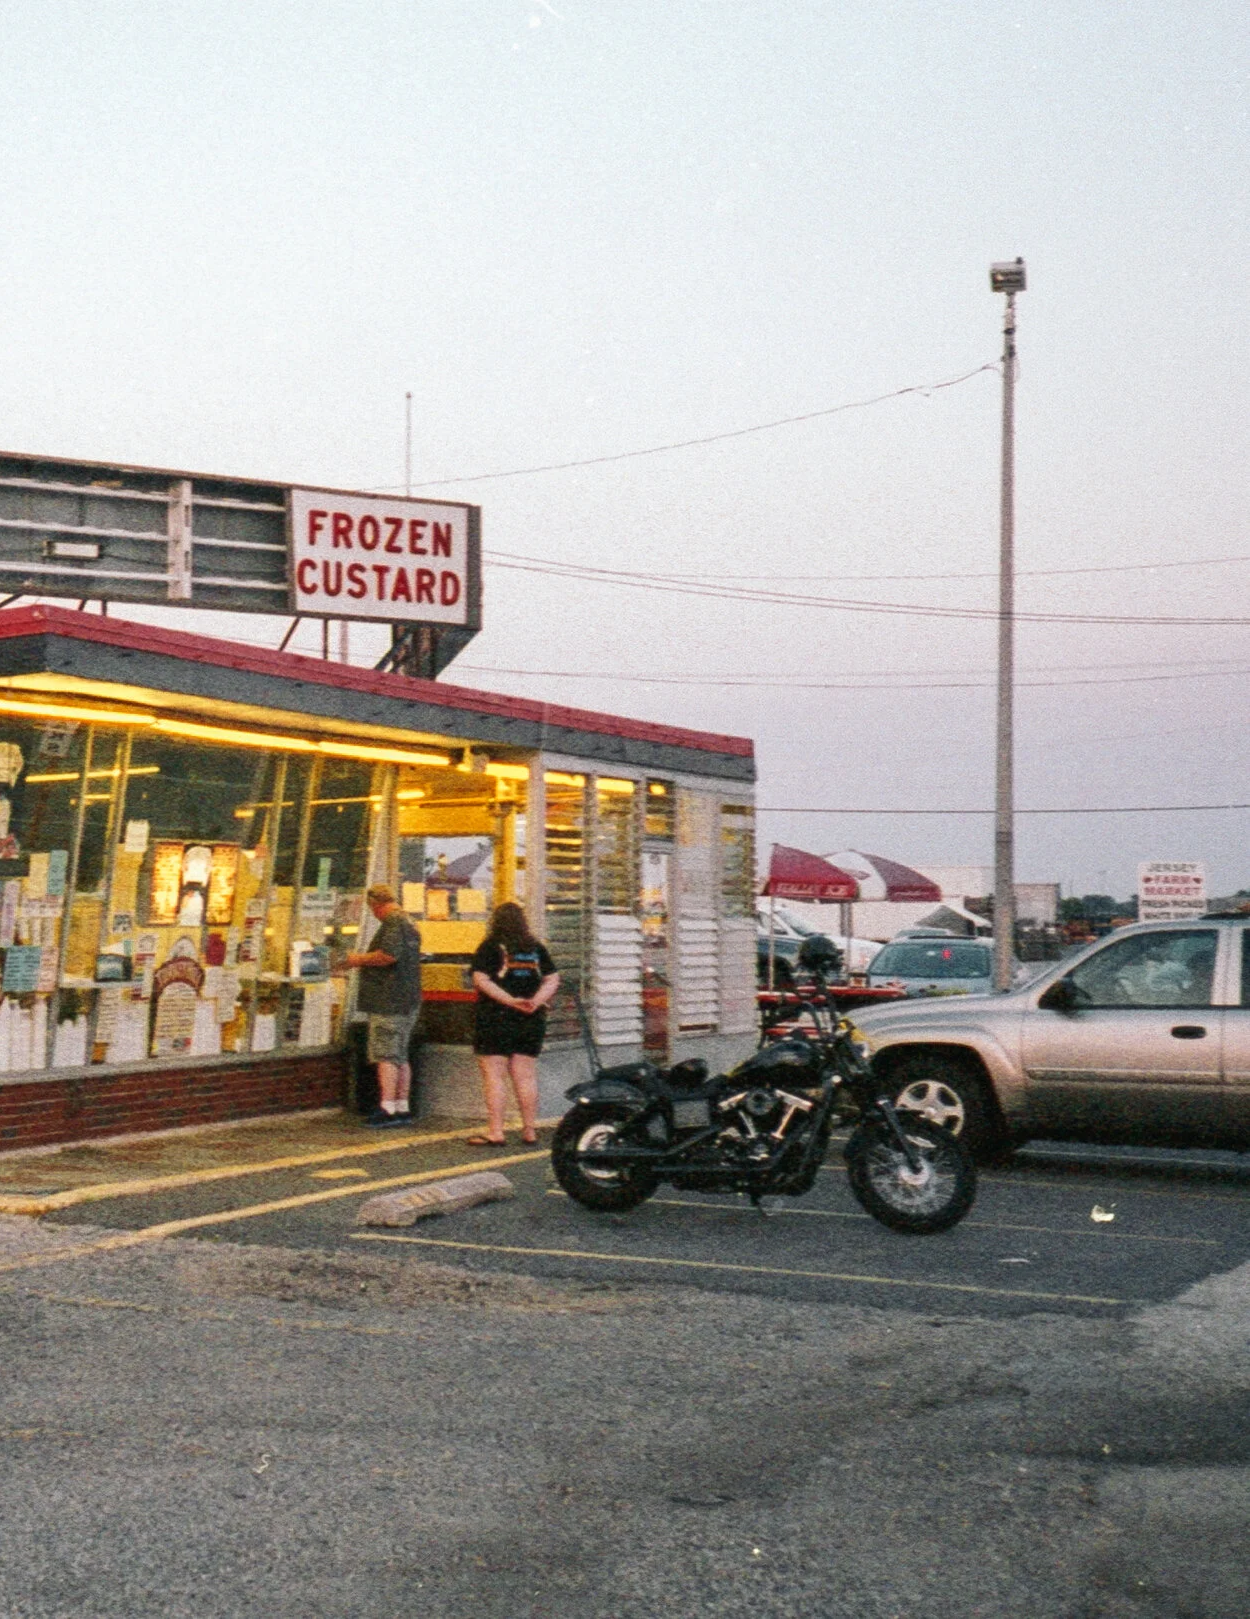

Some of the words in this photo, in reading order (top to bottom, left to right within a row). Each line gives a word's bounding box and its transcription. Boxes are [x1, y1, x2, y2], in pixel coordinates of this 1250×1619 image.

[308, 510, 452, 558] FROZEN
[296, 558, 461, 607] CUSTARD
[1147, 863, 1198, 873] JERSEY
[1154, 875, 1191, 884] FARM
[1144, 886, 1201, 895] MARKET
